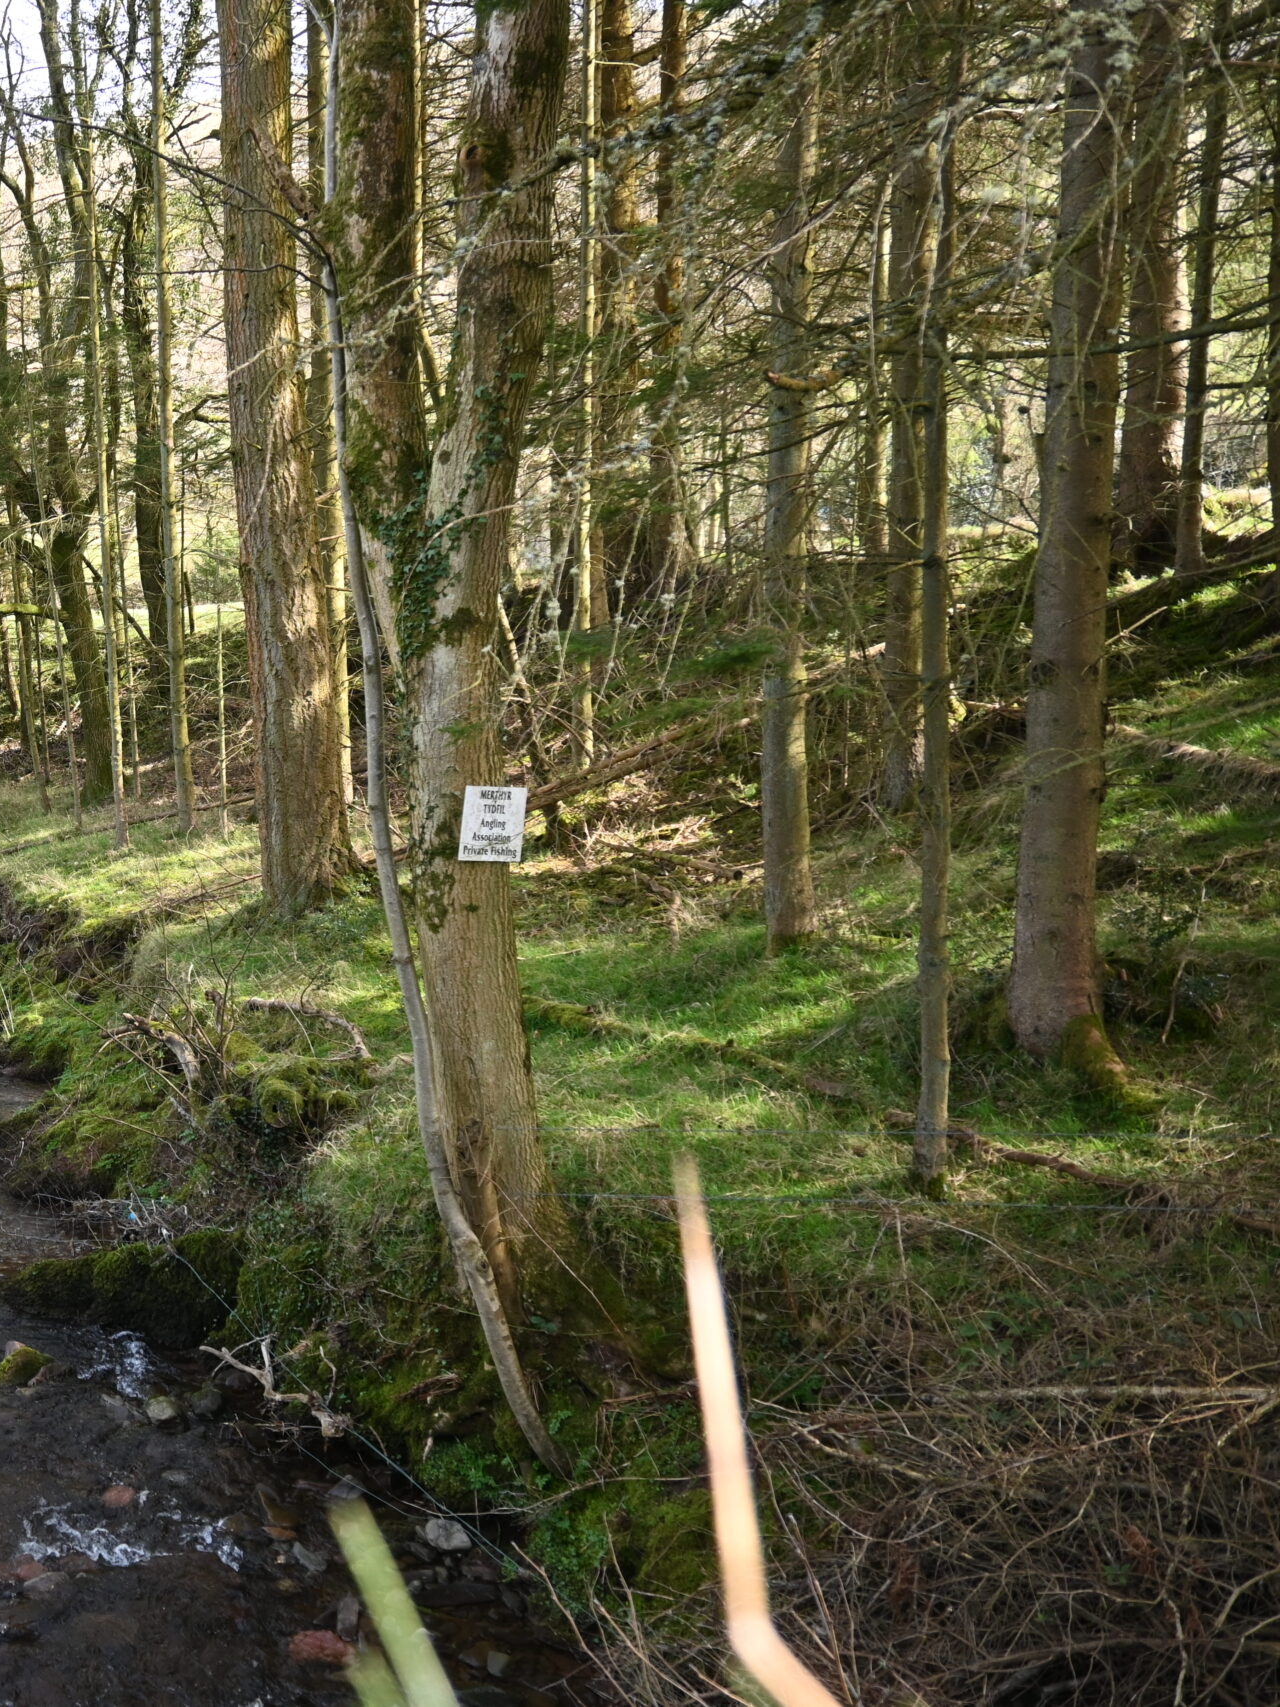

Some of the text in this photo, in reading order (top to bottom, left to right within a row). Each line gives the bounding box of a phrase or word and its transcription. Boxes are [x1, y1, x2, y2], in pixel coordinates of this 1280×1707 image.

[480, 790, 512, 801] MERTHYR
[483, 804, 506, 815] TYDFIL
[480, 818, 506, 831] Angling
[472, 832, 511, 842] Association
[463, 845, 517, 859] Private Fishing
